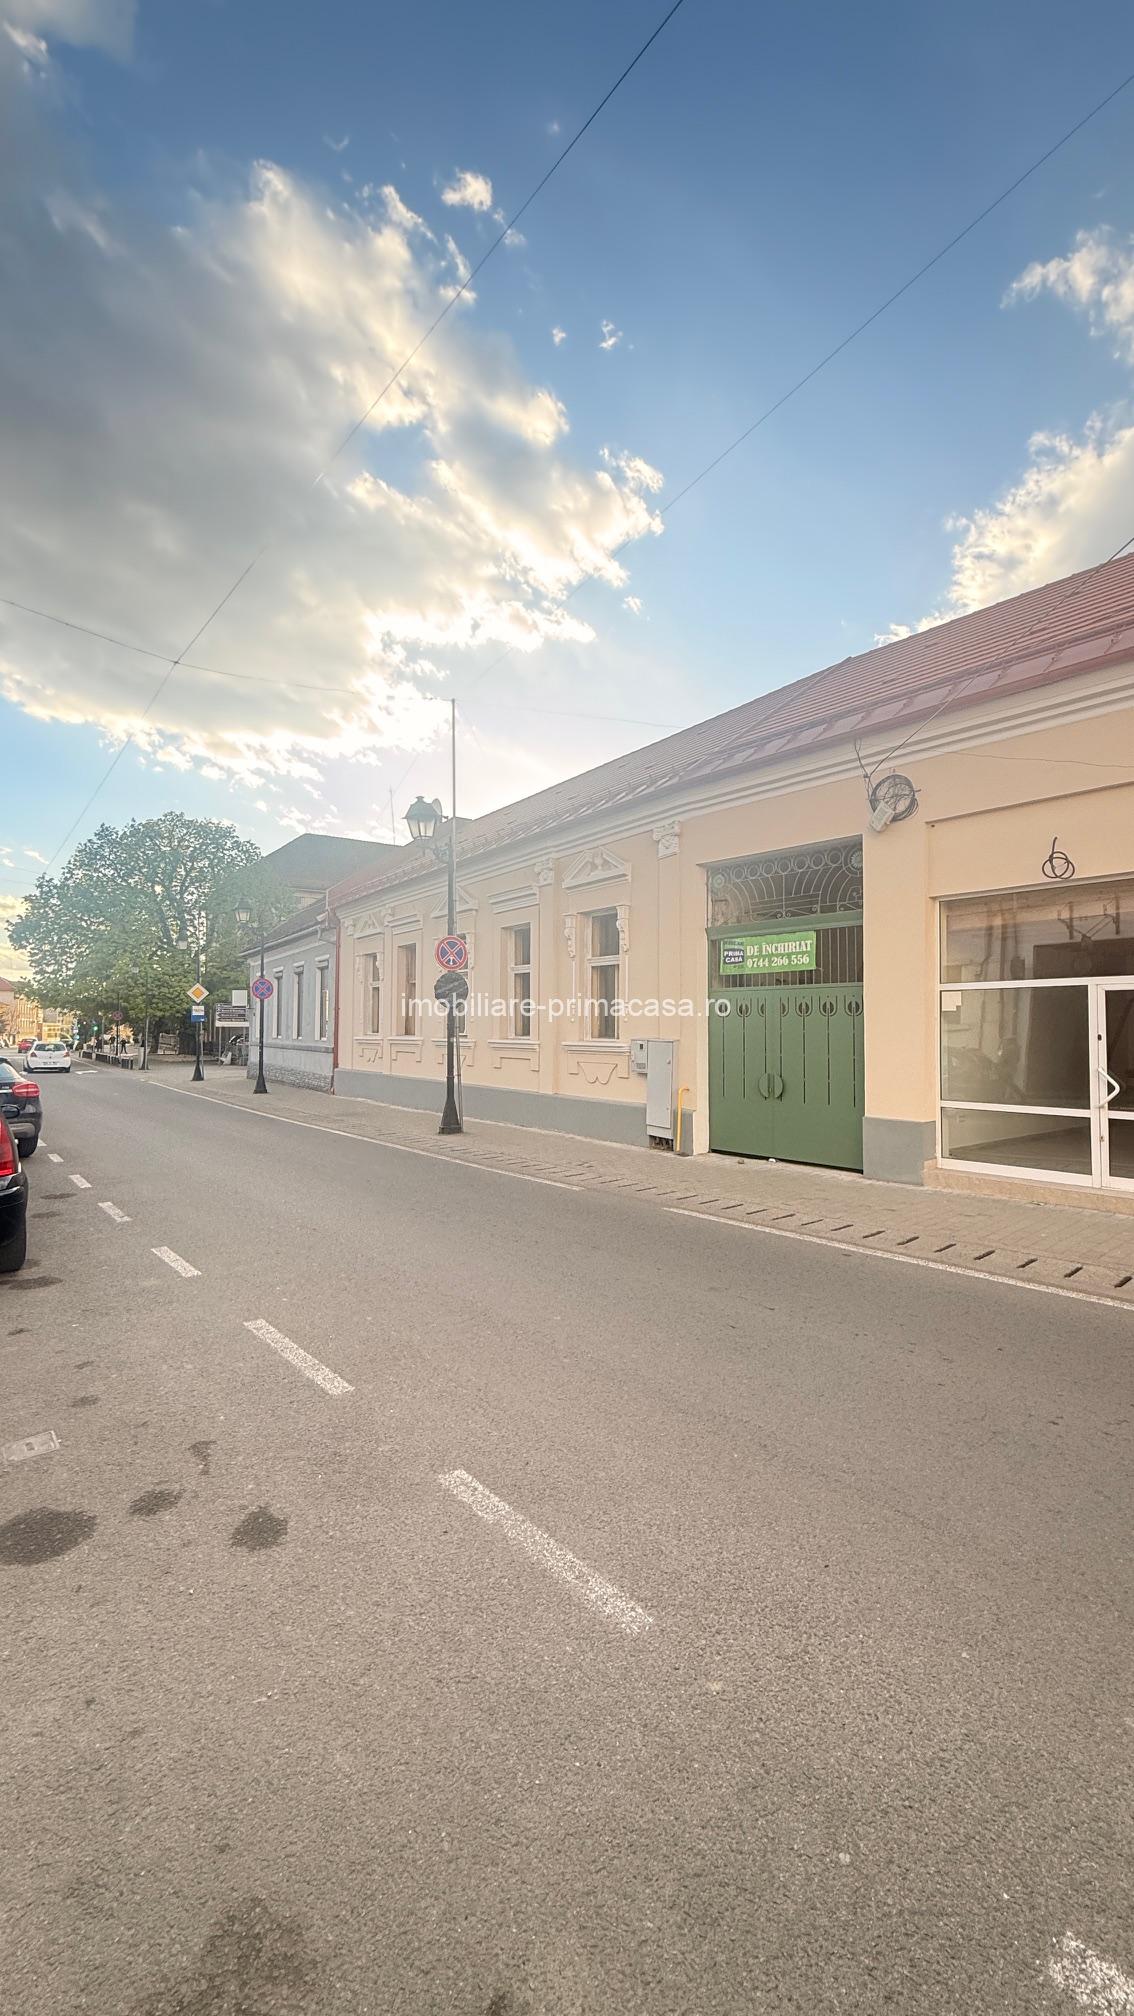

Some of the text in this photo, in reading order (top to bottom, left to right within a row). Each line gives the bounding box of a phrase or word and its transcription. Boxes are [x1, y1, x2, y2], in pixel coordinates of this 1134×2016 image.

[747, 945, 760, 956] DE
[746, 953, 810, 968] 0744 266 556
